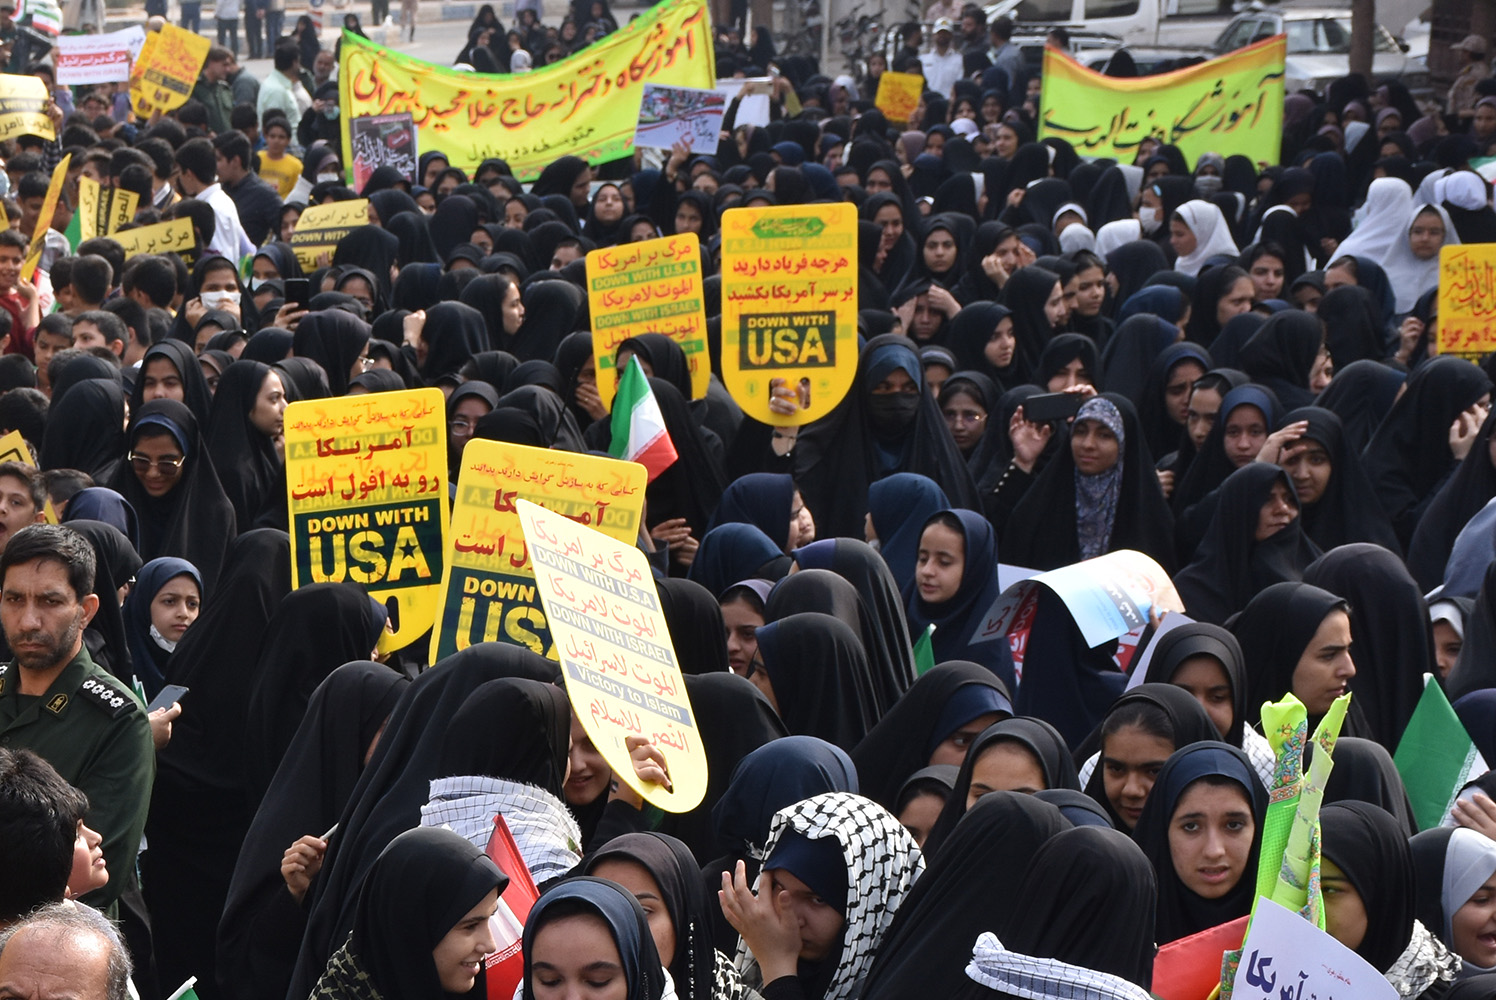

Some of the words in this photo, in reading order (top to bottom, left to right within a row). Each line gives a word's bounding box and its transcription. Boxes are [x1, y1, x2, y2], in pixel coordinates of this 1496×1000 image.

[598, 248, 641, 272] امریکا
[645, 250, 658, 266] بر
[662, 240, 691, 261] مرگ
[733, 257, 771, 277] دارید
[773, 254, 807, 276] فریاد
[810, 255, 848, 274] هرچه
[654, 278, 693, 300] الموت
[728, 288, 770, 305] بکشید
[772, 282, 816, 304] آمریکا
[821, 288, 838, 302] سر
[841, 284, 854, 301] بر
[597, 314, 630, 327] DOWN
[632, 309, 659, 322] WITH
[660, 301, 699, 316] ISRAEL
[747, 316, 789, 329] DOWN
[792, 315, 829, 327] WITH
[747, 328, 828, 365] USA
[413, 407, 435, 419] کسانی
[316, 425, 415, 460] آمریکا
[292, 476, 334, 501] است
[341, 470, 385, 501] افول
[392, 473, 410, 494] به
[417, 474, 440, 494] رو
[611, 486, 638, 496] کسانی
[308, 513, 370, 534] DOWN
[375, 506, 430, 526] WITH
[309, 525, 432, 584] USA
[455, 534, 505, 557] است
[591, 553, 607, 573] بر
[464, 576, 536, 603] DOWN
[575, 664, 625, 697] Victory
[627, 687, 642, 704] to
[645, 693, 683, 721] Islam
